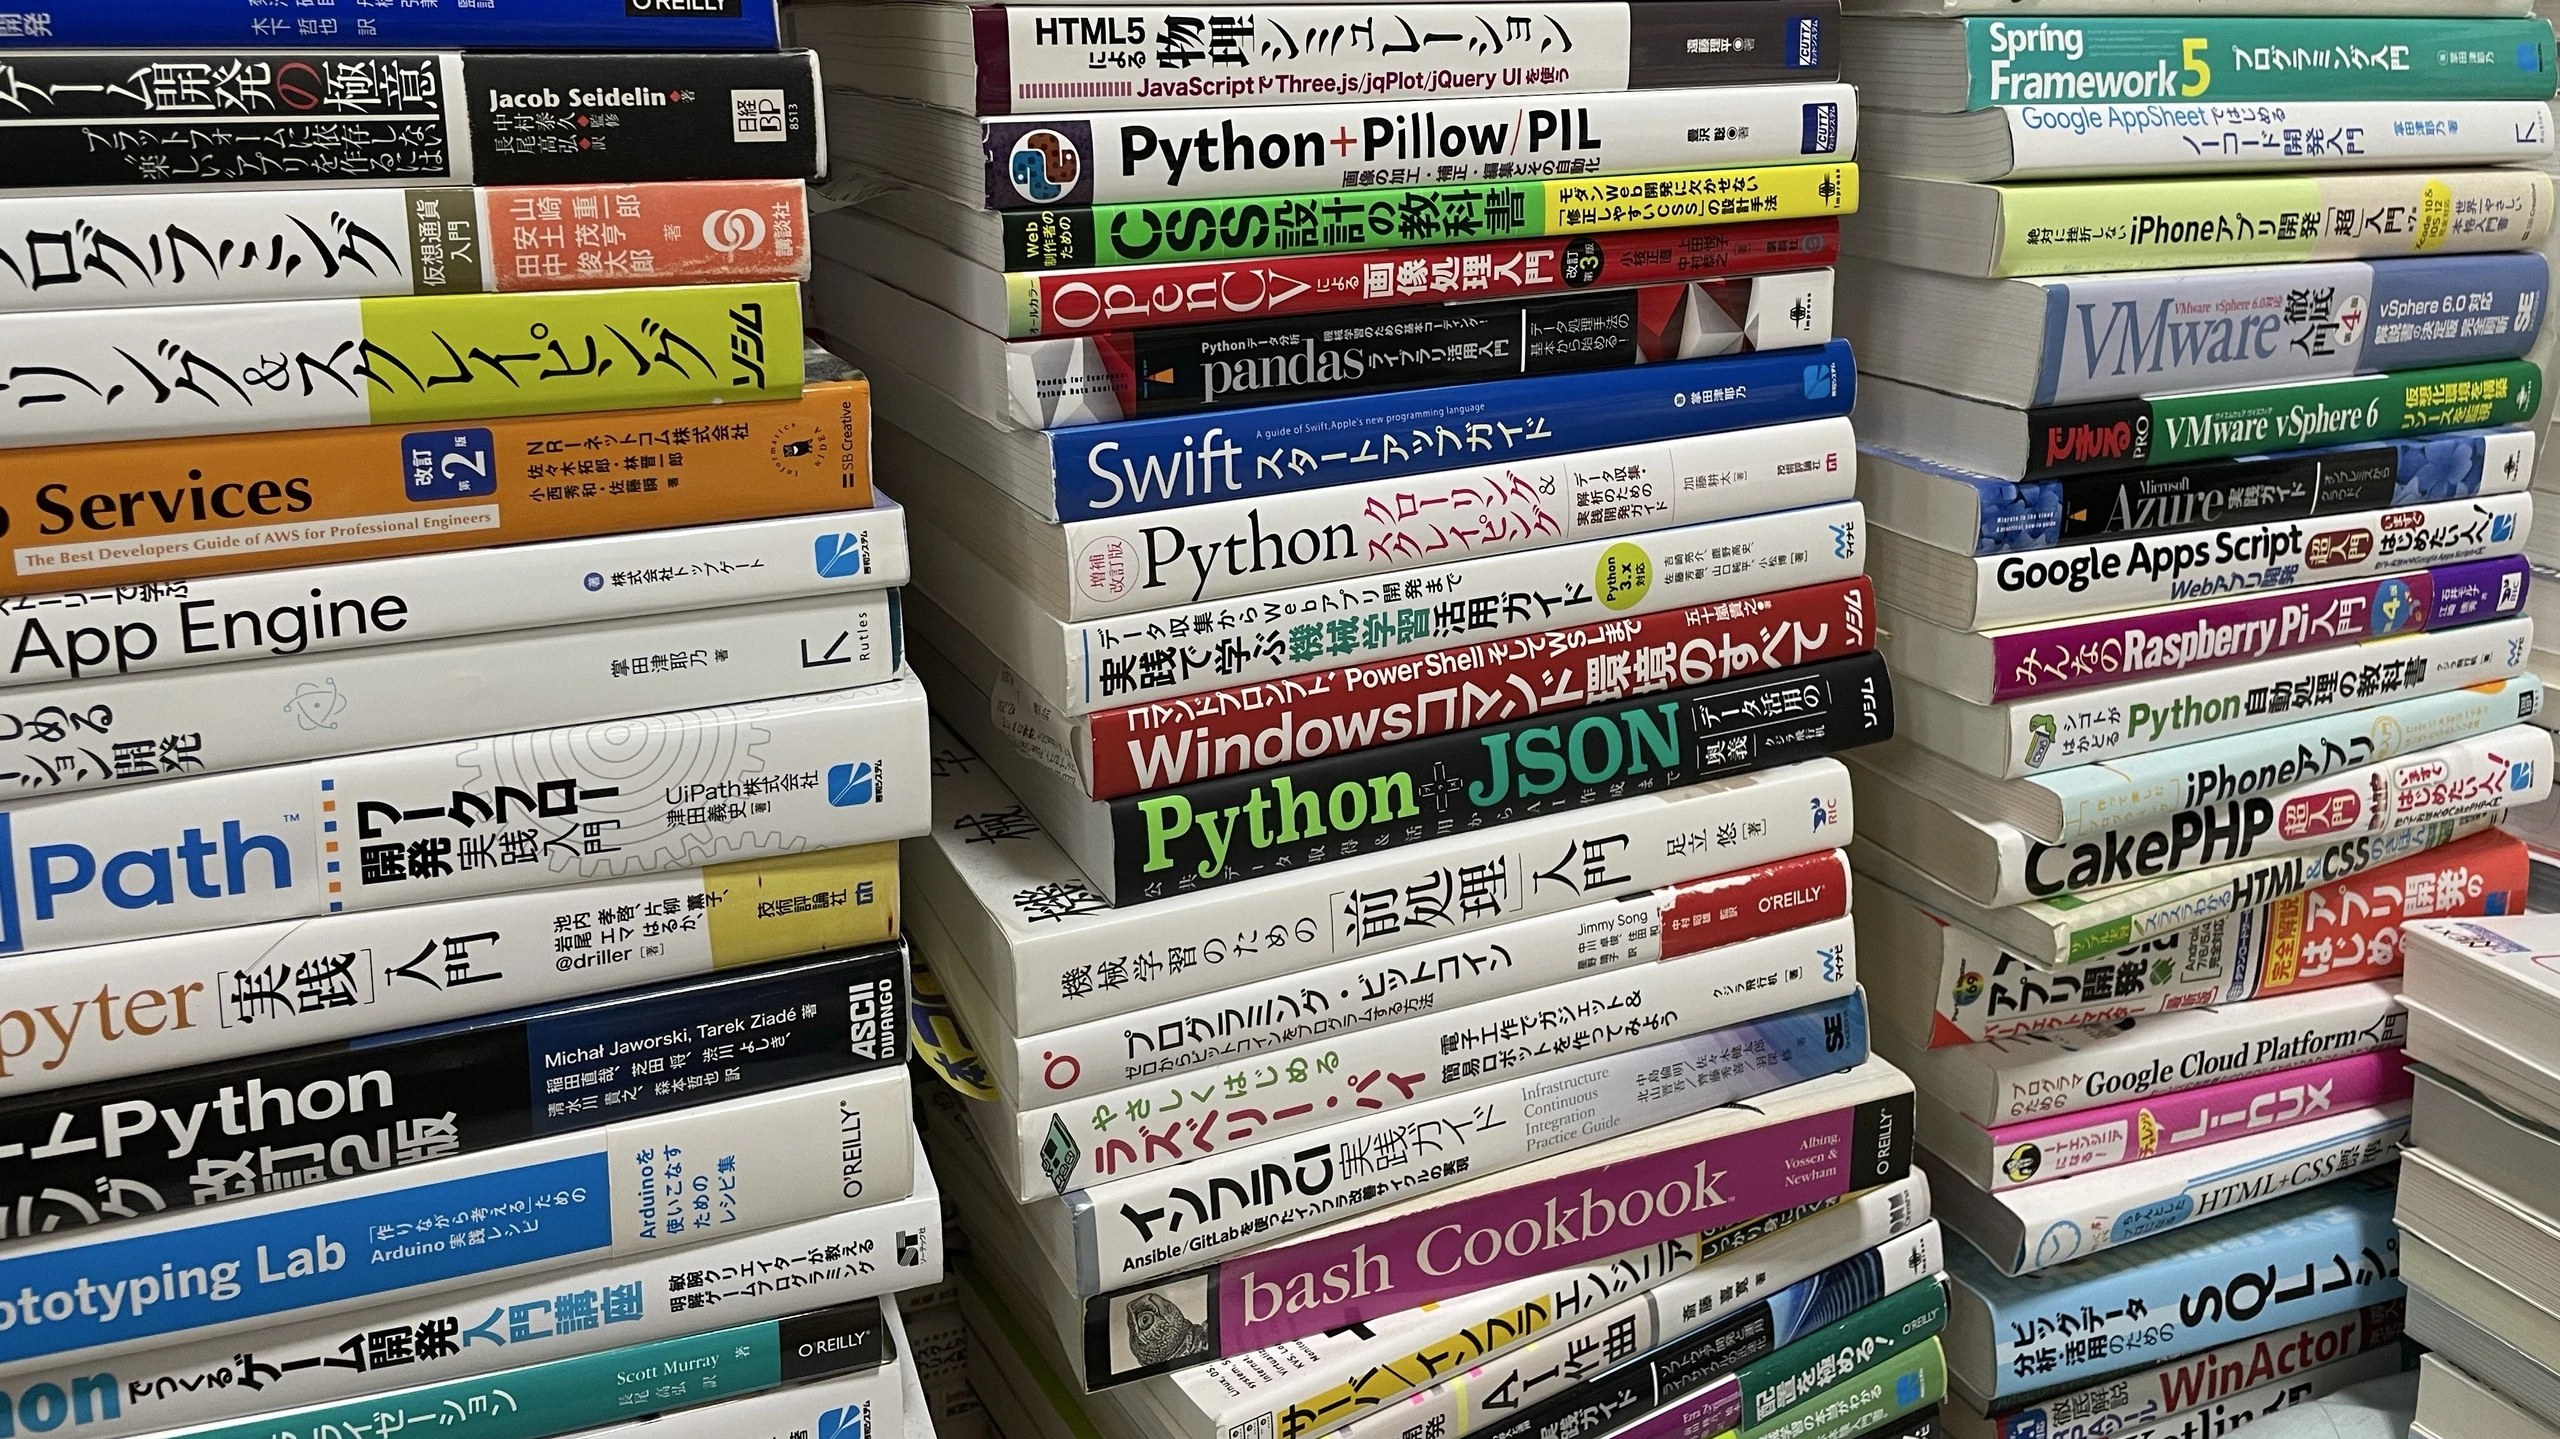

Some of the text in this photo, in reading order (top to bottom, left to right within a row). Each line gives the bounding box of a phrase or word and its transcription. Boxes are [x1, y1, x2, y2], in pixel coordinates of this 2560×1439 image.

[1035, 16, 1146, 46] HTML5
[1156, 13, 1573, 70] 物理シミュレーション
[1989, 22, 2083, 61] Spring
[1089, 50, 1147, 70] による
[1990, 59, 2178, 101] Framework
[2180, 37, 2211, 98] 5
[489, 88, 560, 113] Jacob
[569, 87, 667, 108] Seidelin
[758, 97, 783, 132] BP
[789, 102, 800, 131] 8513
[2022, 105, 2286, 135] Google AppSheetではじめる
[81, 123, 443, 153] プラットフォームに依存しない
[2182, 127, 2365, 158] ノーコード開発入門
[1342, 156, 1602, 188] 画像の加工・補正・編集とその自動化
[1559, 175, 1759, 204] モダンWeb開発に欠かせない
[663, 223, 683, 241] 著
[772, 200, 792, 258] 講談社
[1110, 187, 1526, 260] CSS設計の教科書
[1558, 194, 1778, 226] 「修正しやすいCSS」の設計手法
[421, 199, 446, 286] 仮想通貨
[451, 219, 473, 264] 入門
[1025, 221, 1039, 259] Web
[1043, 209, 1055, 267] 制作者の
[1060, 215, 1073, 260] ための
[1565, 249, 1578, 279] 改訂
[1028, 278, 1040, 335] オールカラー
[1051, 248, 1556, 329] OpenCV による 画像処理入門
[729, 303, 764, 390] ソシム
[1201, 333, 1301, 356] Pythonデータ分析
[1530, 312, 1630, 337] データ処理手法の
[2075, 297, 2281, 380] VMware
[1200, 339, 1365, 405] pandas
[1368, 338, 1510, 370] ライブラリ活用入門
[841, 401, 854, 471] SB Creative
[1256, 402, 1486, 441] A guide of Swift,Apple's new programming language
[2045, 415, 2149, 468] できる PRO
[2165, 413, 2268, 450] VMware
[2275, 402, 2362, 444] vSphere
[2365, 396, 2381, 429] 6
[412, 449, 433, 486] 改訂
[1088, 416, 1553, 510] Swift スタートアップガイド
[1575, 464, 1647, 488] データ収集・
[2138, 476, 2191, 496] Microsoft
[36, 469, 313, 535] Services
[1576, 500, 1669, 527] 実践開発ガイド
[26, 512, 492, 568] The Best Developers Guide of AWS for Professional Engineers
[1138, 508, 1358, 602] Python
[1368, 500, 1563, 563] スクレイピング
[1846, 521, 1855, 560] マイナビ
[1089, 554, 1106, 588] 増補
[1108, 541, 1124, 594] 改訂版
[1606, 556, 1616, 602] Python
[1619, 562, 1632, 591] 3.x
[1635, 561, 1647, 587] 対応
[1997, 546, 2121, 593] Google
[2126, 541, 2210, 582] Apps
[2215, 524, 2303, 567] Script
[2309, 531, 2370, 565] 超入門
[10, 588, 409, 679] App Engine
[859, 611, 868, 661] Rutles
[1098, 572, 1463, 650] データ収集からWebアプリ開発まで
[1844, 588, 1863, 647] ソシム
[1099, 582, 1594, 697] 実践で学ぶ機械学習活用ガイド
[1127, 620, 1829, 789] Windowsコマンド環境のすべて
[1699, 683, 1822, 729] データ活用の
[1861, 676, 1878, 729] ソシム
[2062, 706, 2122, 732] シゴトが
[2126, 655, 2428, 742] Python 自動処理の教科書
[665, 769, 819, 805] UiPath株式会社
[1137, 702, 1682, 879] Python JSON
[2184, 735, 2375, 811] iPhoneアプリ
[357, 778, 620, 840] ワークフロー
[1828, 798, 1838, 825] RIC
[2024, 796, 2275, 897] CakePHP
[2285, 792, 2356, 836] 超入門
[757, 889, 847, 920] 技術評論社
[1576, 910, 1648, 937] Jimmy Song
[2305, 866, 2484, 933] アプリ開発の
[555, 931, 592, 954] 岩尾
[600, 925, 636, 944] エマ
[1834, 942, 1844, 982] マイナビ
[1124, 943, 1513, 1059] プログラミング・ビットコイン
[1986, 957, 2149, 1017] アプリ開発
[545, 1003, 818, 1069] Michał Jaworski, Tarek Ziadé 著
[849, 980, 878, 1061] ASCII
[881, 978, 894, 1060] DWANGO
[1125, 992, 1434, 1081] ゼロからビットコインをプログラムする方法
[1823, 1012, 1845, 1053] SE
[1441, 1010, 1679, 1085] 簡易ロボットを作ってみよう
[2085, 1059, 2173, 1098] Google
[2179, 1042, 2248, 1080] Cloud
[1092, 1050, 1340, 1132] やさしくはじめる
[1521, 1066, 1610, 1103] Infrastructure
[1523, 1088, 1599, 1119] Continuous
[2170, 1077, 2333, 1144] Linux
[1095, 1068, 1427, 1175] ラズベリー・パイ
[1525, 1106, 1596, 1137] Integration
[1525, 1114, 1621, 1154] Practice Guide
[1799, 1132, 1841, 1151] Albing,
[1784, 1149, 1838, 1170] Vossen &
[1784, 1165, 1837, 1188] Newham
[637, 1147, 658, 1240] Arduinoを
[664, 1145, 685, 1235] 使いこなす
[693, 1175, 710, 1228] ための
[717, 1154, 737, 1223] レシピ集
[370, 1218, 540, 1264] Arduino 実践レシピ
[668, 1237, 875, 1293] 敏腕クリエイターが教える
[1241, 1159, 1728, 1327] bash Cookbook
[670, 1259, 876, 1313] 明解ゲームプログラミング
[2011, 1296, 2148, 1349] ビッグデータ
[616, 1366, 658, 1386] Scott
[663, 1352, 720, 1380] Murray
[2159, 1320, 2357, 1414] WinActor
